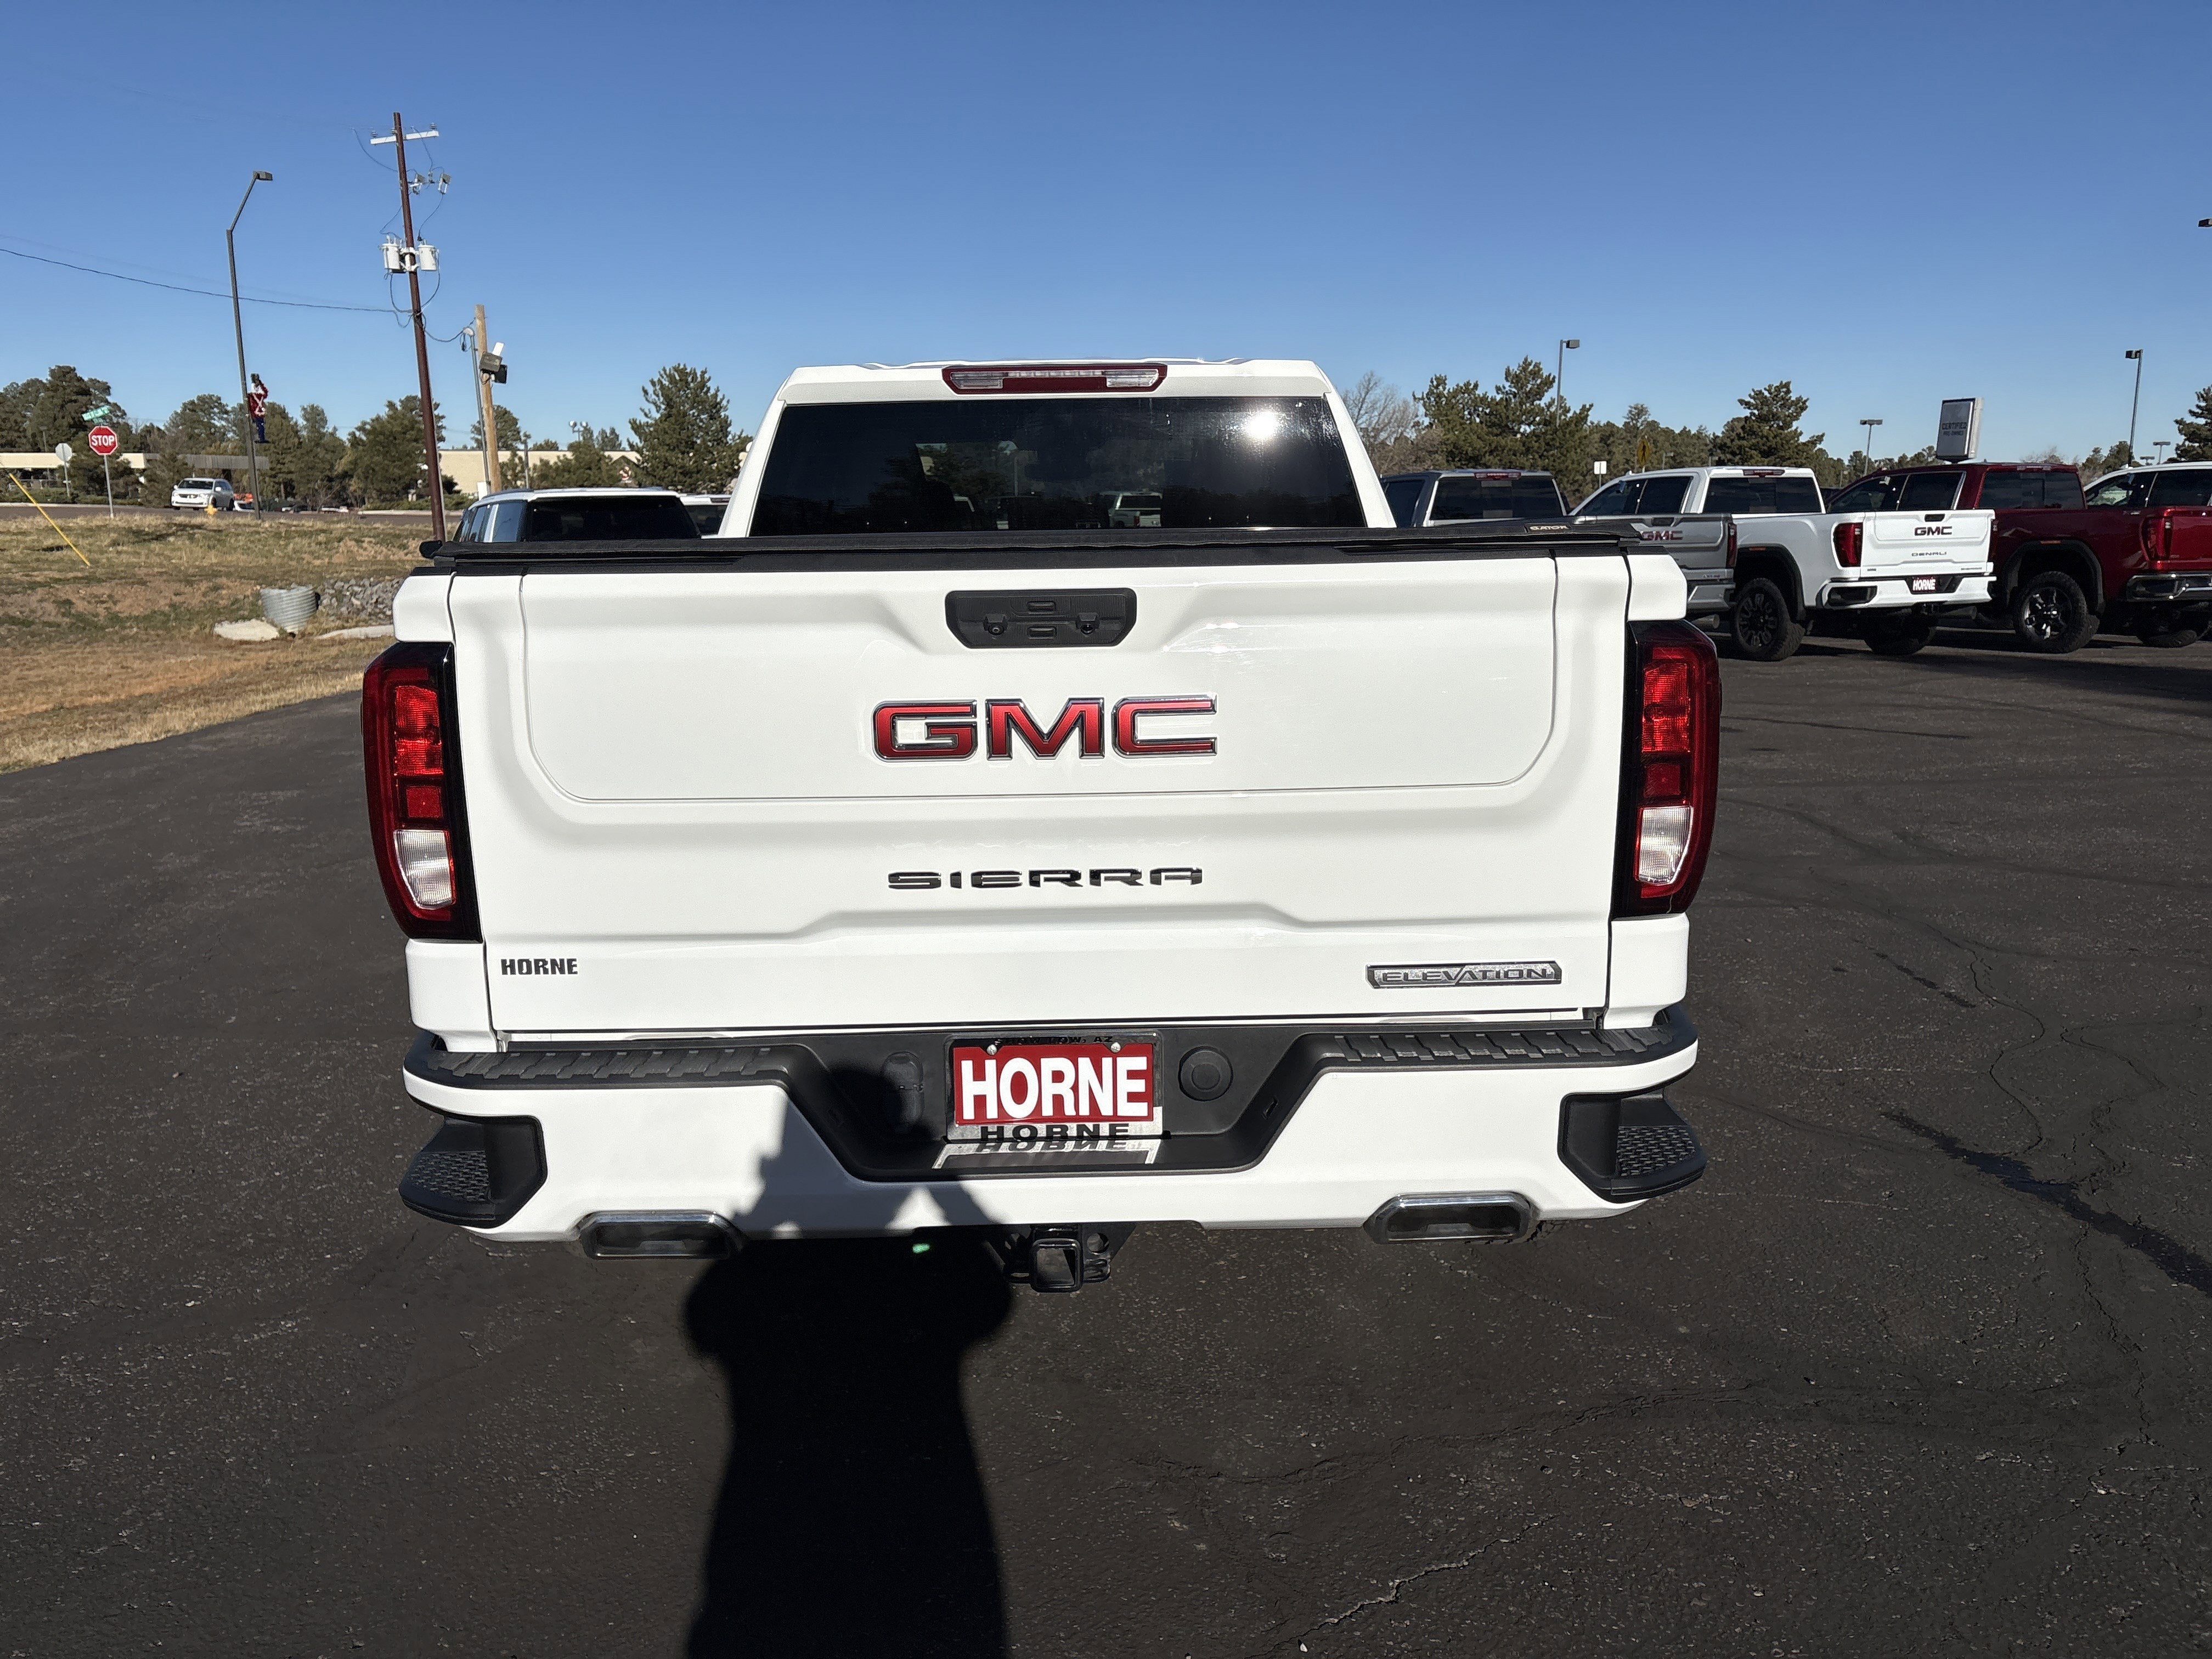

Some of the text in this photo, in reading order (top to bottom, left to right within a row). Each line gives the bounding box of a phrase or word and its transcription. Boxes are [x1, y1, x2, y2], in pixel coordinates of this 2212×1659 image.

[91, 435, 115, 446] STOP
[1641, 530, 1683, 541] GMC
[1914, 526, 1953, 536] GMC
[1912, 578, 1936, 591] HORNE
[872, 695, 1217, 762] GMC
[888, 867, 1203, 889] SIERRA
[500, 958, 578, 975] HORNE
[1382, 968, 1547, 983] ELEVATION
[961, 1057, 1149, 1120] HORNE
[980, 1122, 1130, 1142] HORNE
